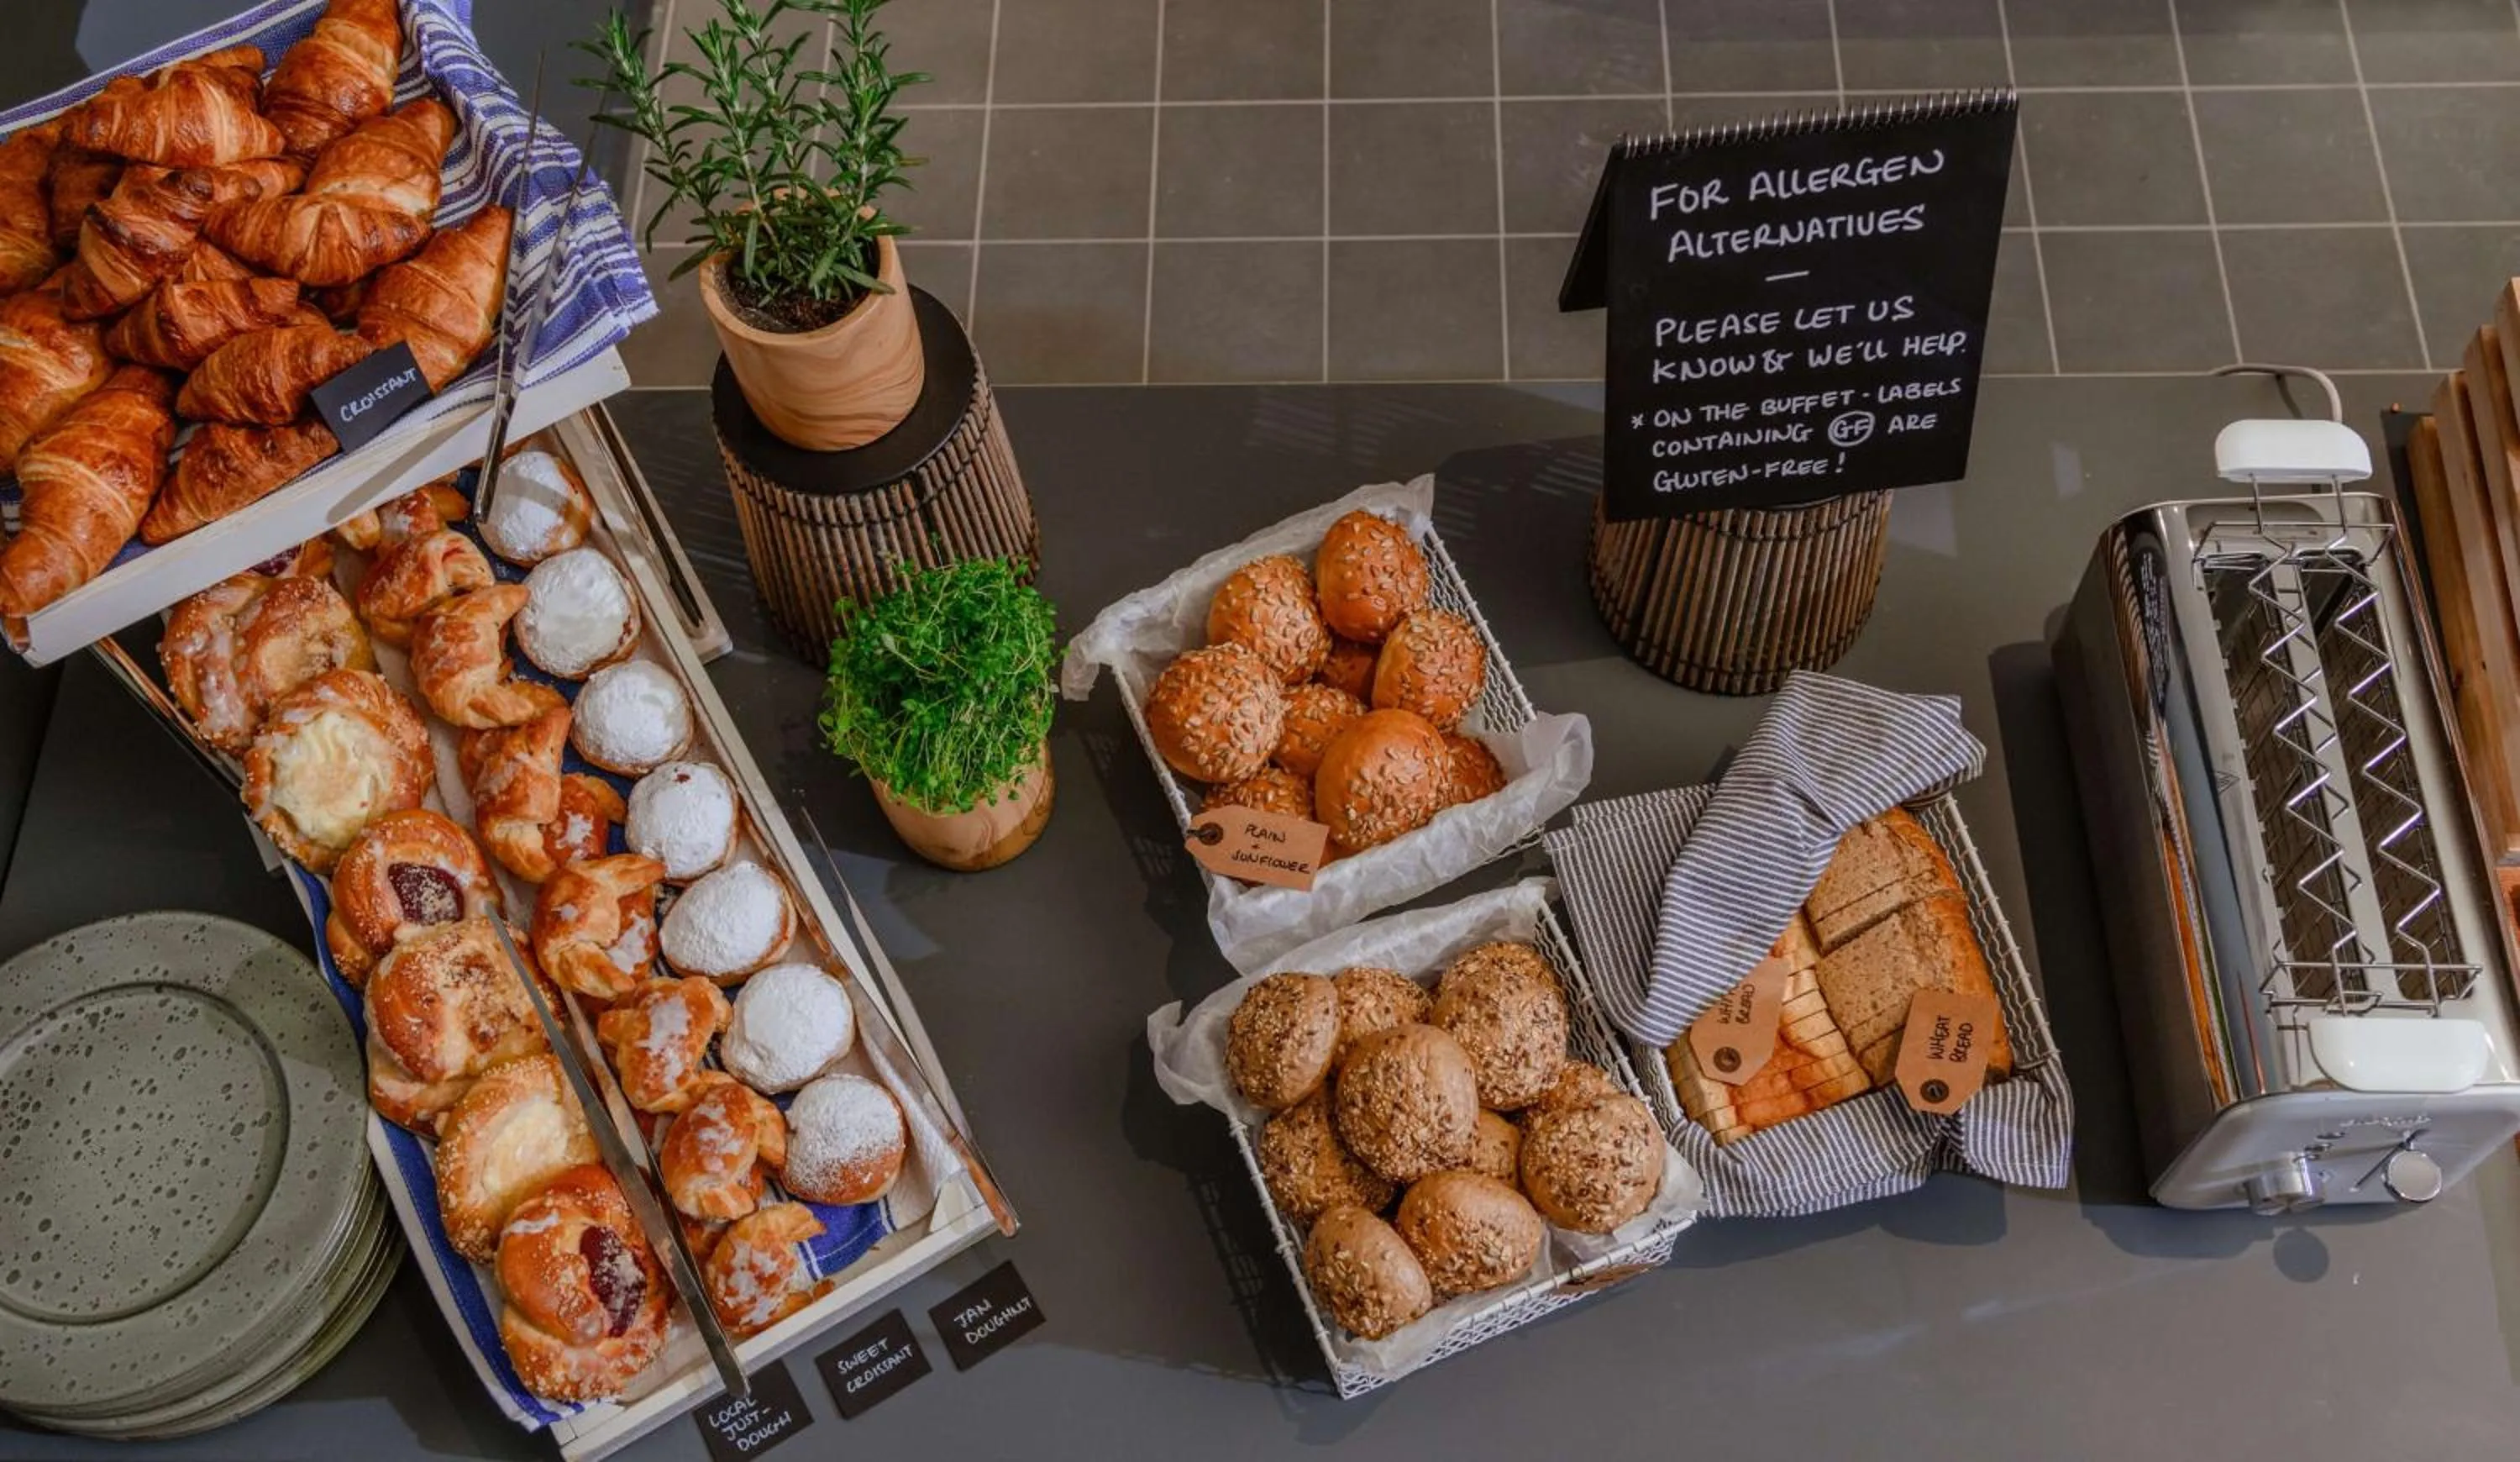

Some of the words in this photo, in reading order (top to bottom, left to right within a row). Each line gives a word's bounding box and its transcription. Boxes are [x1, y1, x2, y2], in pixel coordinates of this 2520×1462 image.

[1650, 179, 1730, 220] FOR
[1749, 149, 1945, 202] ALLERGEN
[1667, 204, 1925, 263] ALTERNATIVES
[1656, 312, 1782, 347] PLEASE
[1794, 305, 1855, 330] LET
[1868, 296, 1915, 322] US
[1651, 359, 1755, 384] KNOW
[1763, 350, 1793, 373] &
[1808, 342, 1887, 368] WE'LL
[1903, 332, 1966, 358] HELP.
[340, 367, 417, 422] CROISSANT
[1653, 410, 1692, 428] ON
[1699, 404, 1750, 423] THE
[1760, 391, 1855, 417] BUFFET
[1877, 378, 1961, 403] LABELS
[1651, 423, 1814, 458] CONTAINING
[1833, 419, 1872, 440] GF
[1887, 414, 1937, 435] ARE
[1926, 1015, 1950, 1060] WHEAT
[1949, 1023, 1973, 1062] BREAD
[837, 1337, 888, 1375] SWEET
[846, 1344, 913, 1393] CROISSANT
[708, 1397, 757, 1428] LOCAL
[737, 1411, 792, 1451] DOUGH
